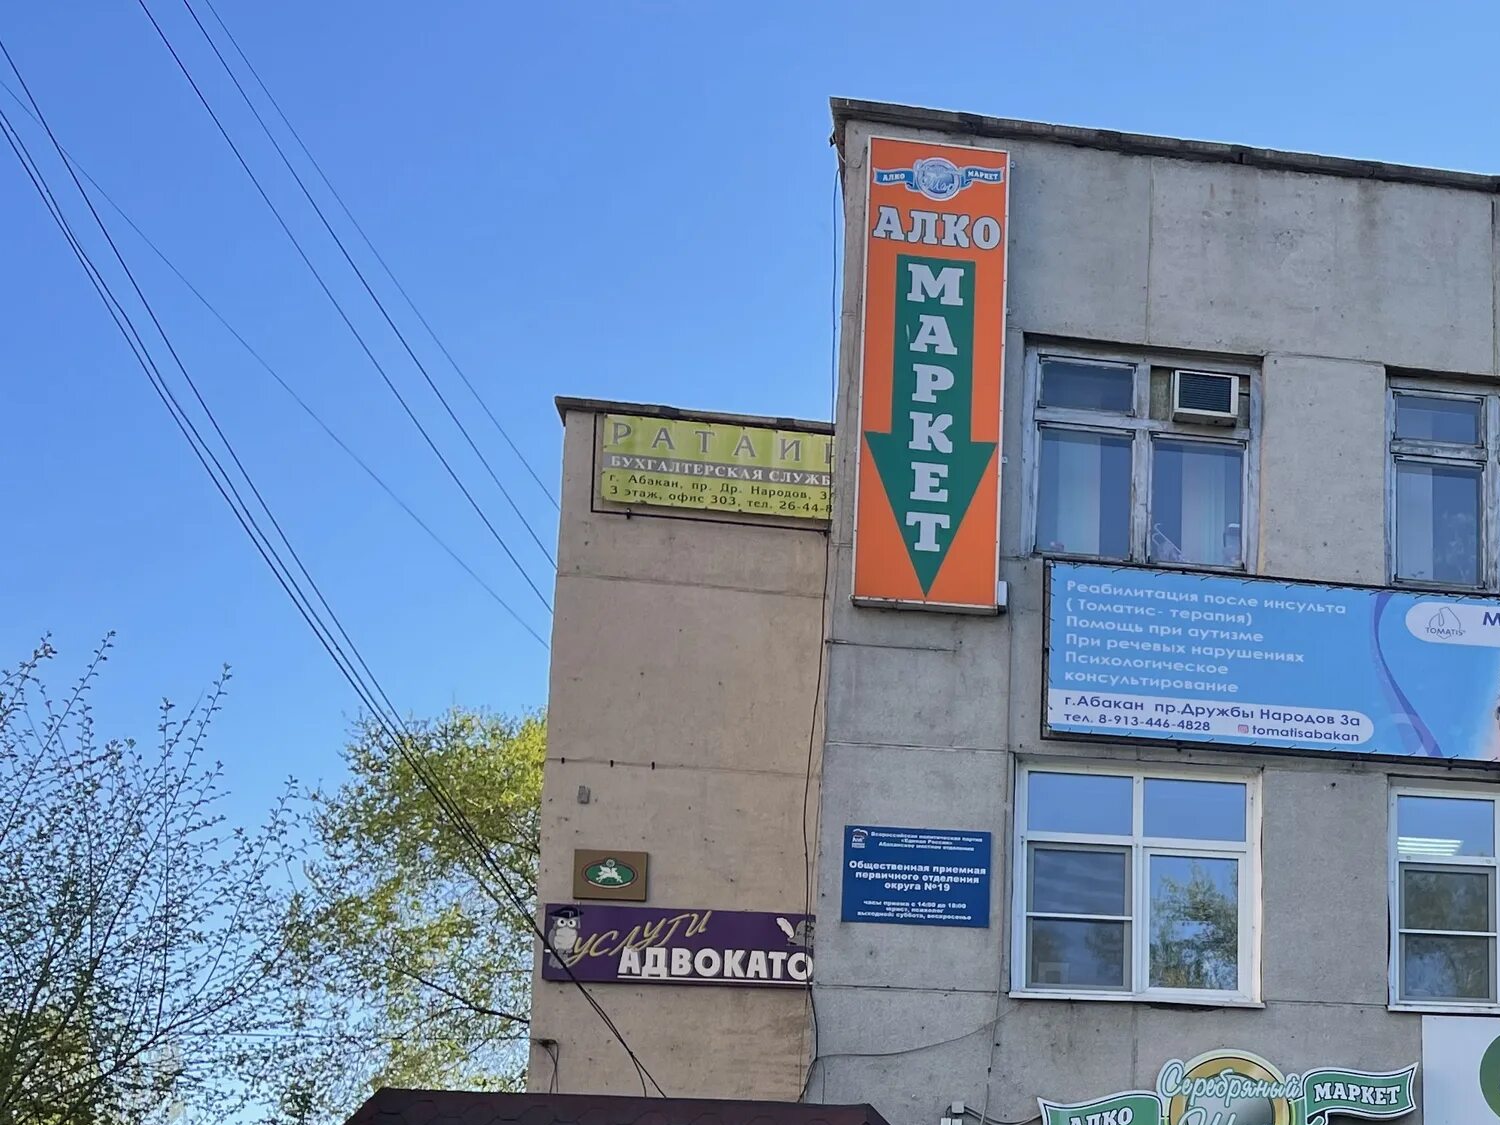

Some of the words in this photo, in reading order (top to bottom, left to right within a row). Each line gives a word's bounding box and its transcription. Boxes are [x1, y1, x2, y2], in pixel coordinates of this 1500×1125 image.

[968, 171, 998, 180] МАРКЕТ
[873, 205, 1001, 249] АЛКО
[905, 263, 965, 553] МАРКЕТ
[611, 455, 763, 481] БУХГАЛТЕРСКАЯ
[768, 470, 834, 486] СЛУЖБ
[609, 474, 619, 483] г.
[692, 482, 712, 493] пр.
[720, 483, 742, 494] Др.
[609, 485, 618, 495] 3
[669, 491, 704, 505] офис
[748, 499, 773, 509] тел.
[1067, 580, 1199, 603] Реабилитация
[1204, 594, 1258, 608] после
[1264, 599, 1346, 615] инсульта
[1169, 607, 1253, 625] терапия)
[1066, 615, 1144, 634] Помощь
[1149, 624, 1183, 638] при
[1188, 627, 1264, 643] аутизме
[1065, 633, 1101, 648] При
[1106, 638, 1186, 655] речевых
[1191, 645, 1305, 663] нарушениях
[1065, 651, 1229, 675] Психологическое
[1064, 670, 1239, 693] консультирование
[1064, 695, 1144, 712] г.Абакан
[1154, 702, 1254, 720] пр.Дружбы
[1260, 708, 1335, 726] Народов
[1064, 712, 1094, 724] тел.
[1099, 714, 1211, 732] 8-913-446-4828
[1252, 724, 1360, 743] tomatisabakan
[849, 860, 930, 873] Общественная
[932, 866, 987, 876] приемная
[855, 871, 919, 882] первичного
[922, 875, 980, 885] отделения
[884, 882, 921, 892] округа
[1160, 1064, 1303, 1109] Серебряный
[1313, 1081, 1401, 1107] МАРКЕТ
